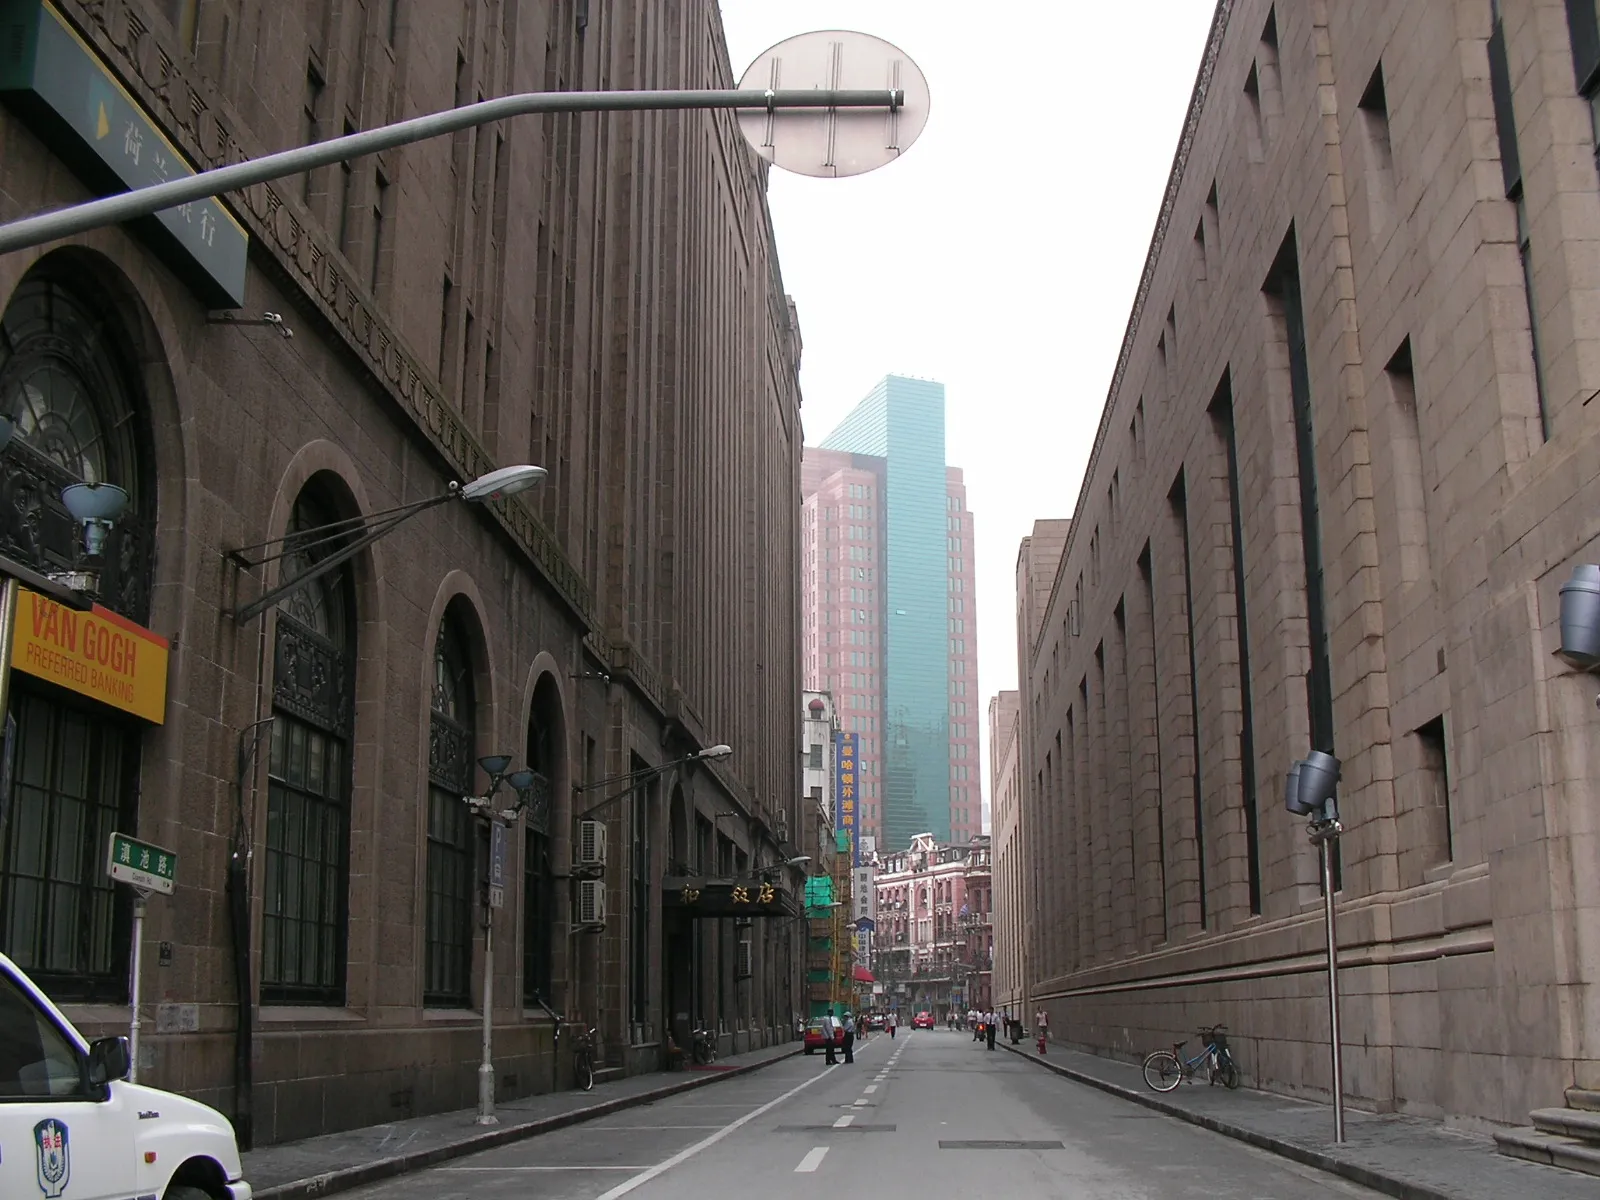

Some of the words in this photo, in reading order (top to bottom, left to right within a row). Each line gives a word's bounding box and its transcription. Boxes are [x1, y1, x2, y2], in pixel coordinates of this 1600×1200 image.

[26, 641, 88, 685] PREFERRED
[91, 668, 134, 704] BANKING
[32, 593, 77, 653] VAN
[83, 619, 137, 678] GOGH
